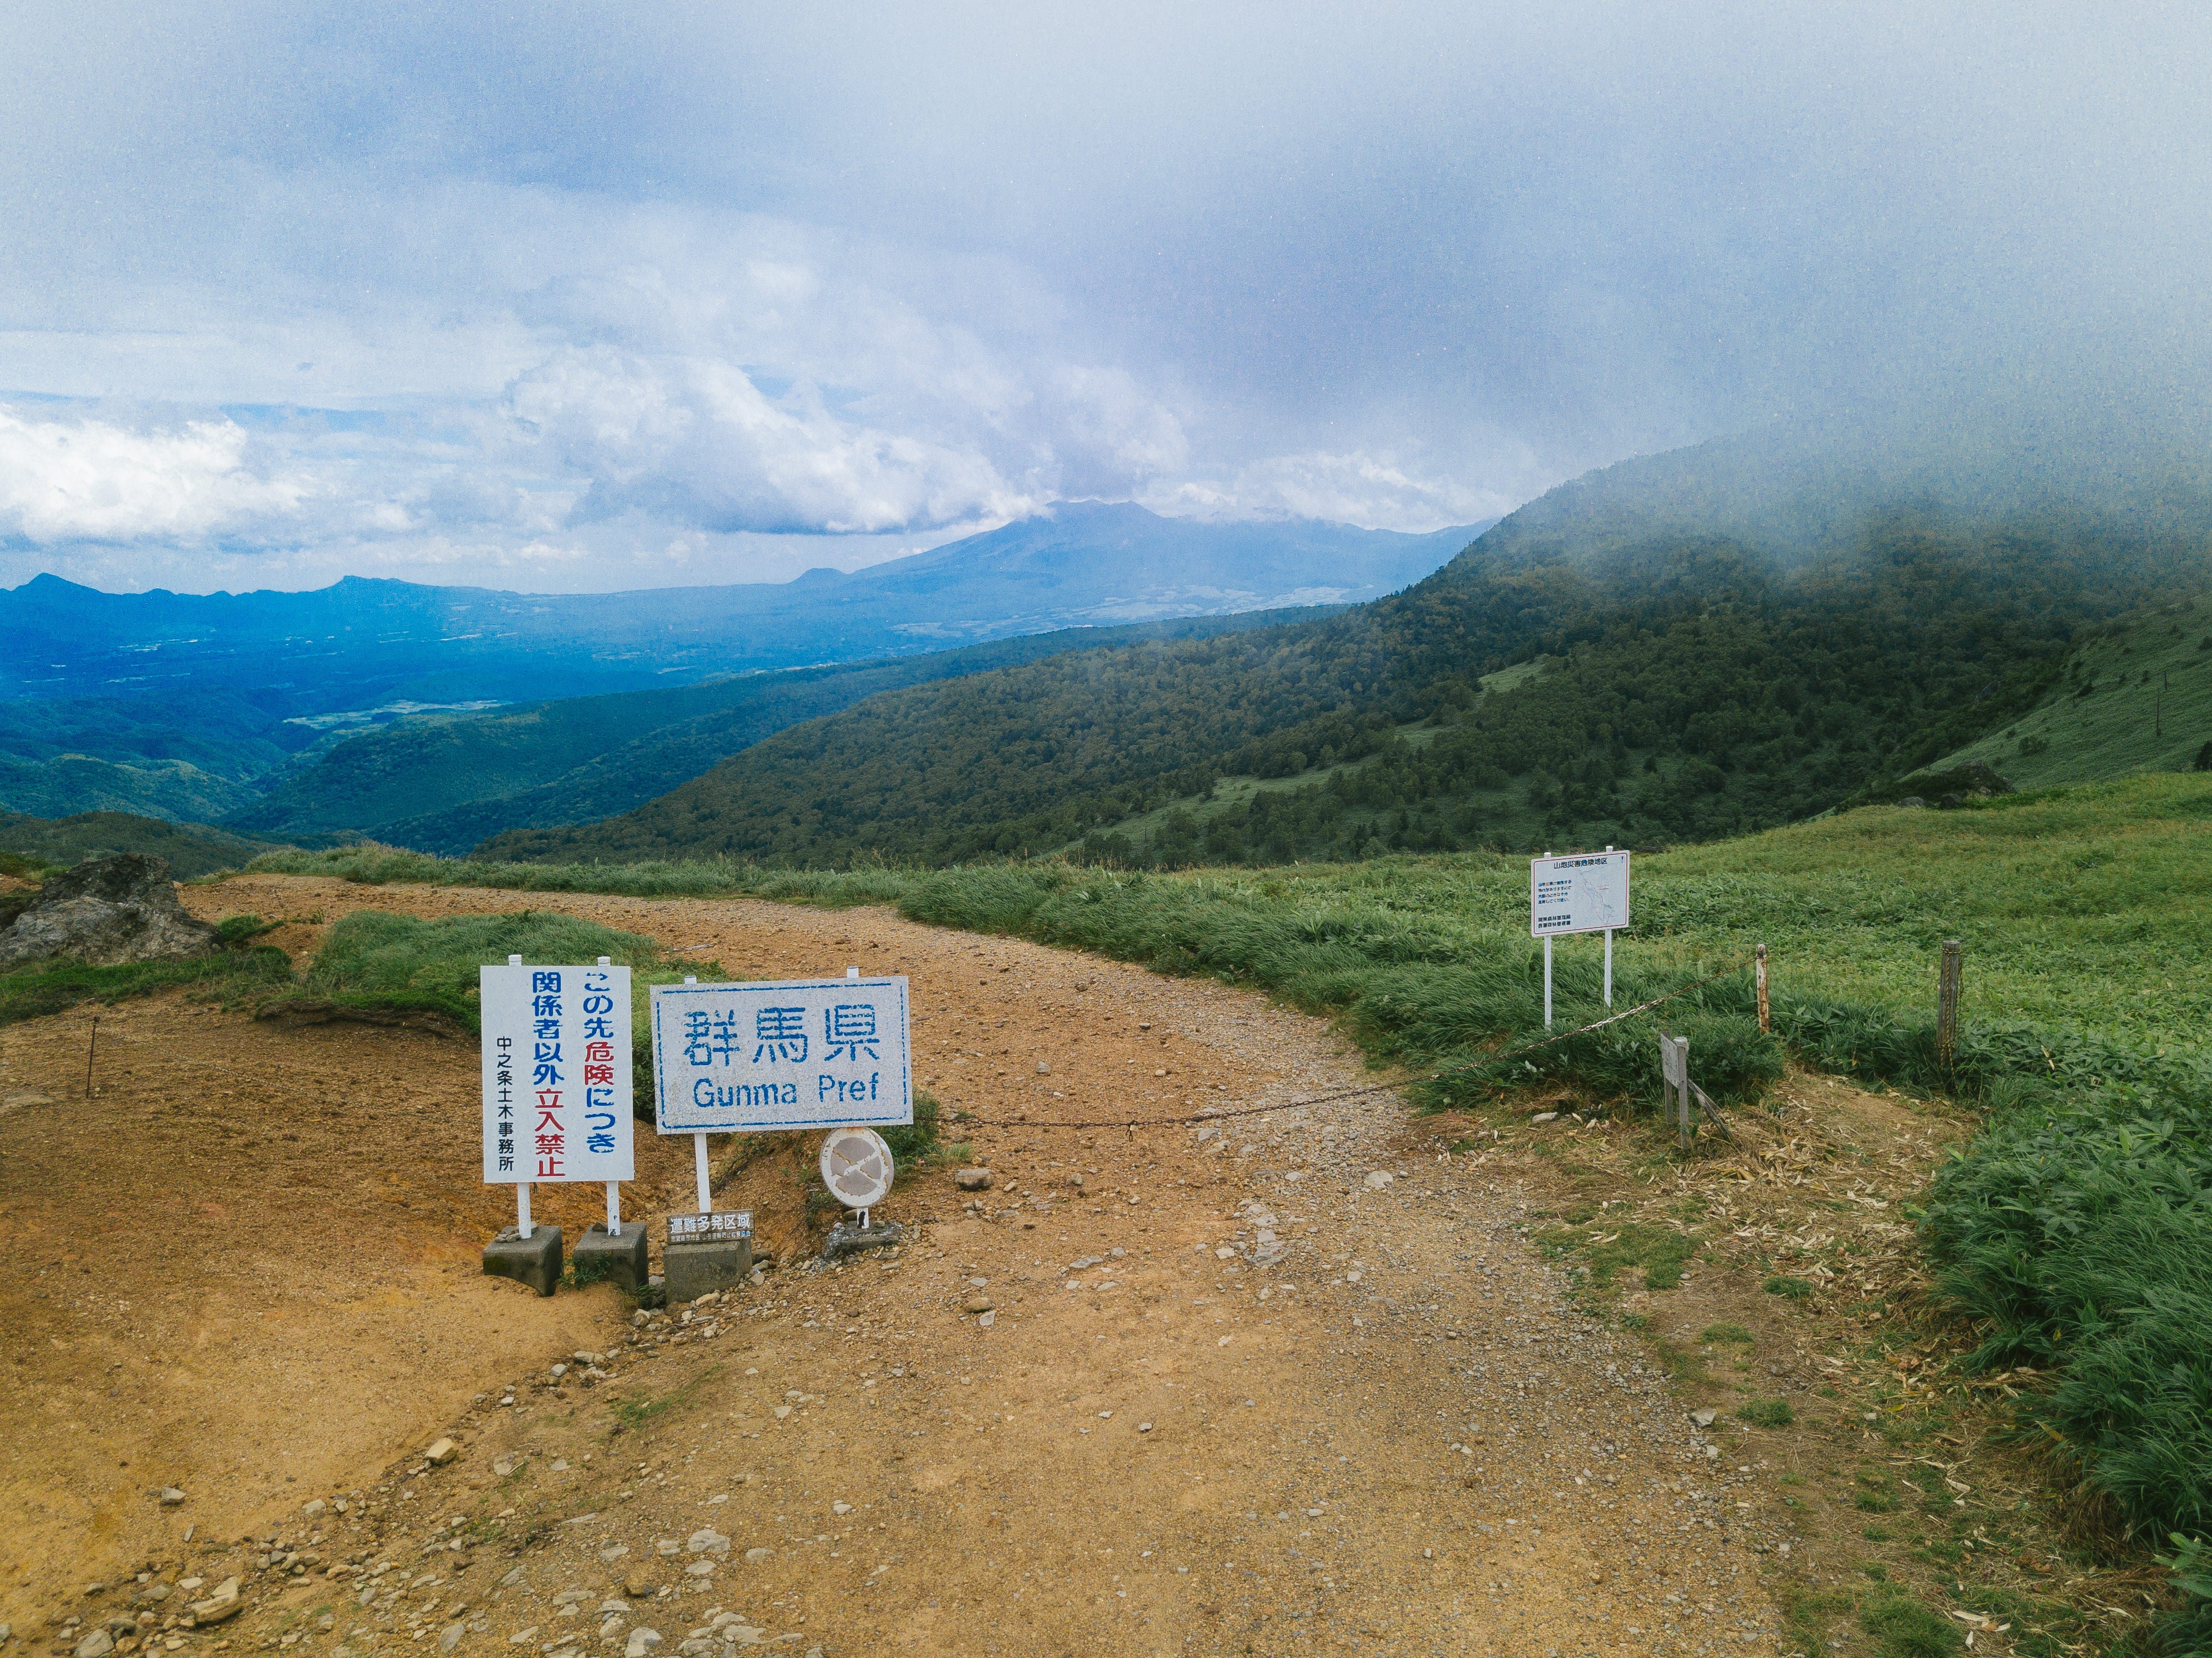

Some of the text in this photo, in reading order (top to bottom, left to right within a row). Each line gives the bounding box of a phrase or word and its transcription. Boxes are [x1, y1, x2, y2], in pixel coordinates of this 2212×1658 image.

[1554, 858, 1607, 869] 山地災害危険地区
[583, 973, 616, 1153] この先危険につき
[684, 1004, 880, 1066] 群馬県
[497, 1036, 514, 1171] 中之条土木事務所
[531, 971, 566, 1176] 関係者以外立入禁止
[693, 1072, 879, 1108] Gunma Pref
[670, 1212, 750, 1234] 遭難多発区域
